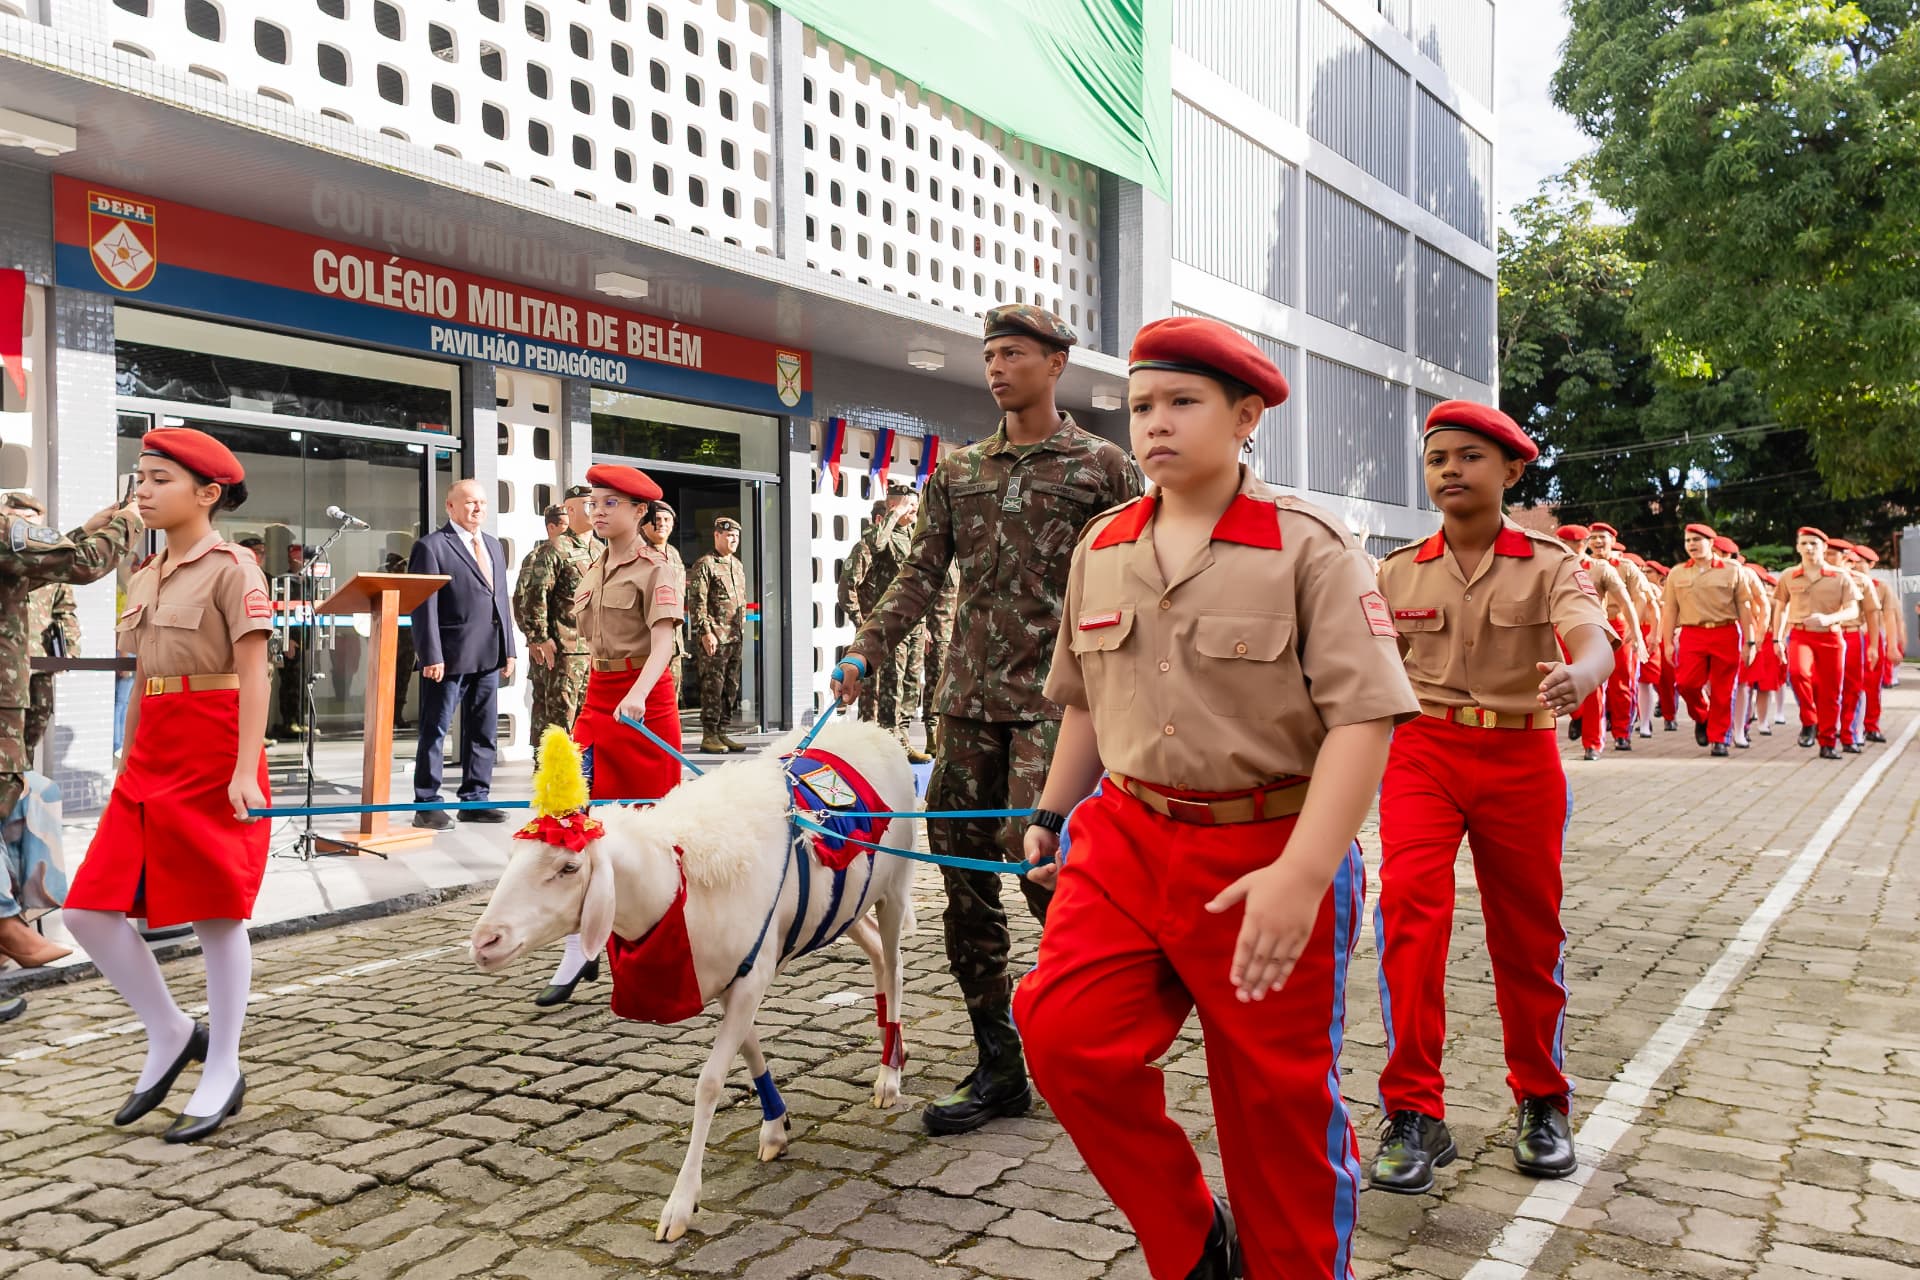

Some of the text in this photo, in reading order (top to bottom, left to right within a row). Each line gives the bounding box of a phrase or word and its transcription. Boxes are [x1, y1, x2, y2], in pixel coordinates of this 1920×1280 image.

[97, 197, 146, 219] DEPA
[313, 249, 702, 369] COLÉGIO MILITAR DE BELÉM
[430, 325, 627, 385] PAVILHÃO PEDAGÓGICO
